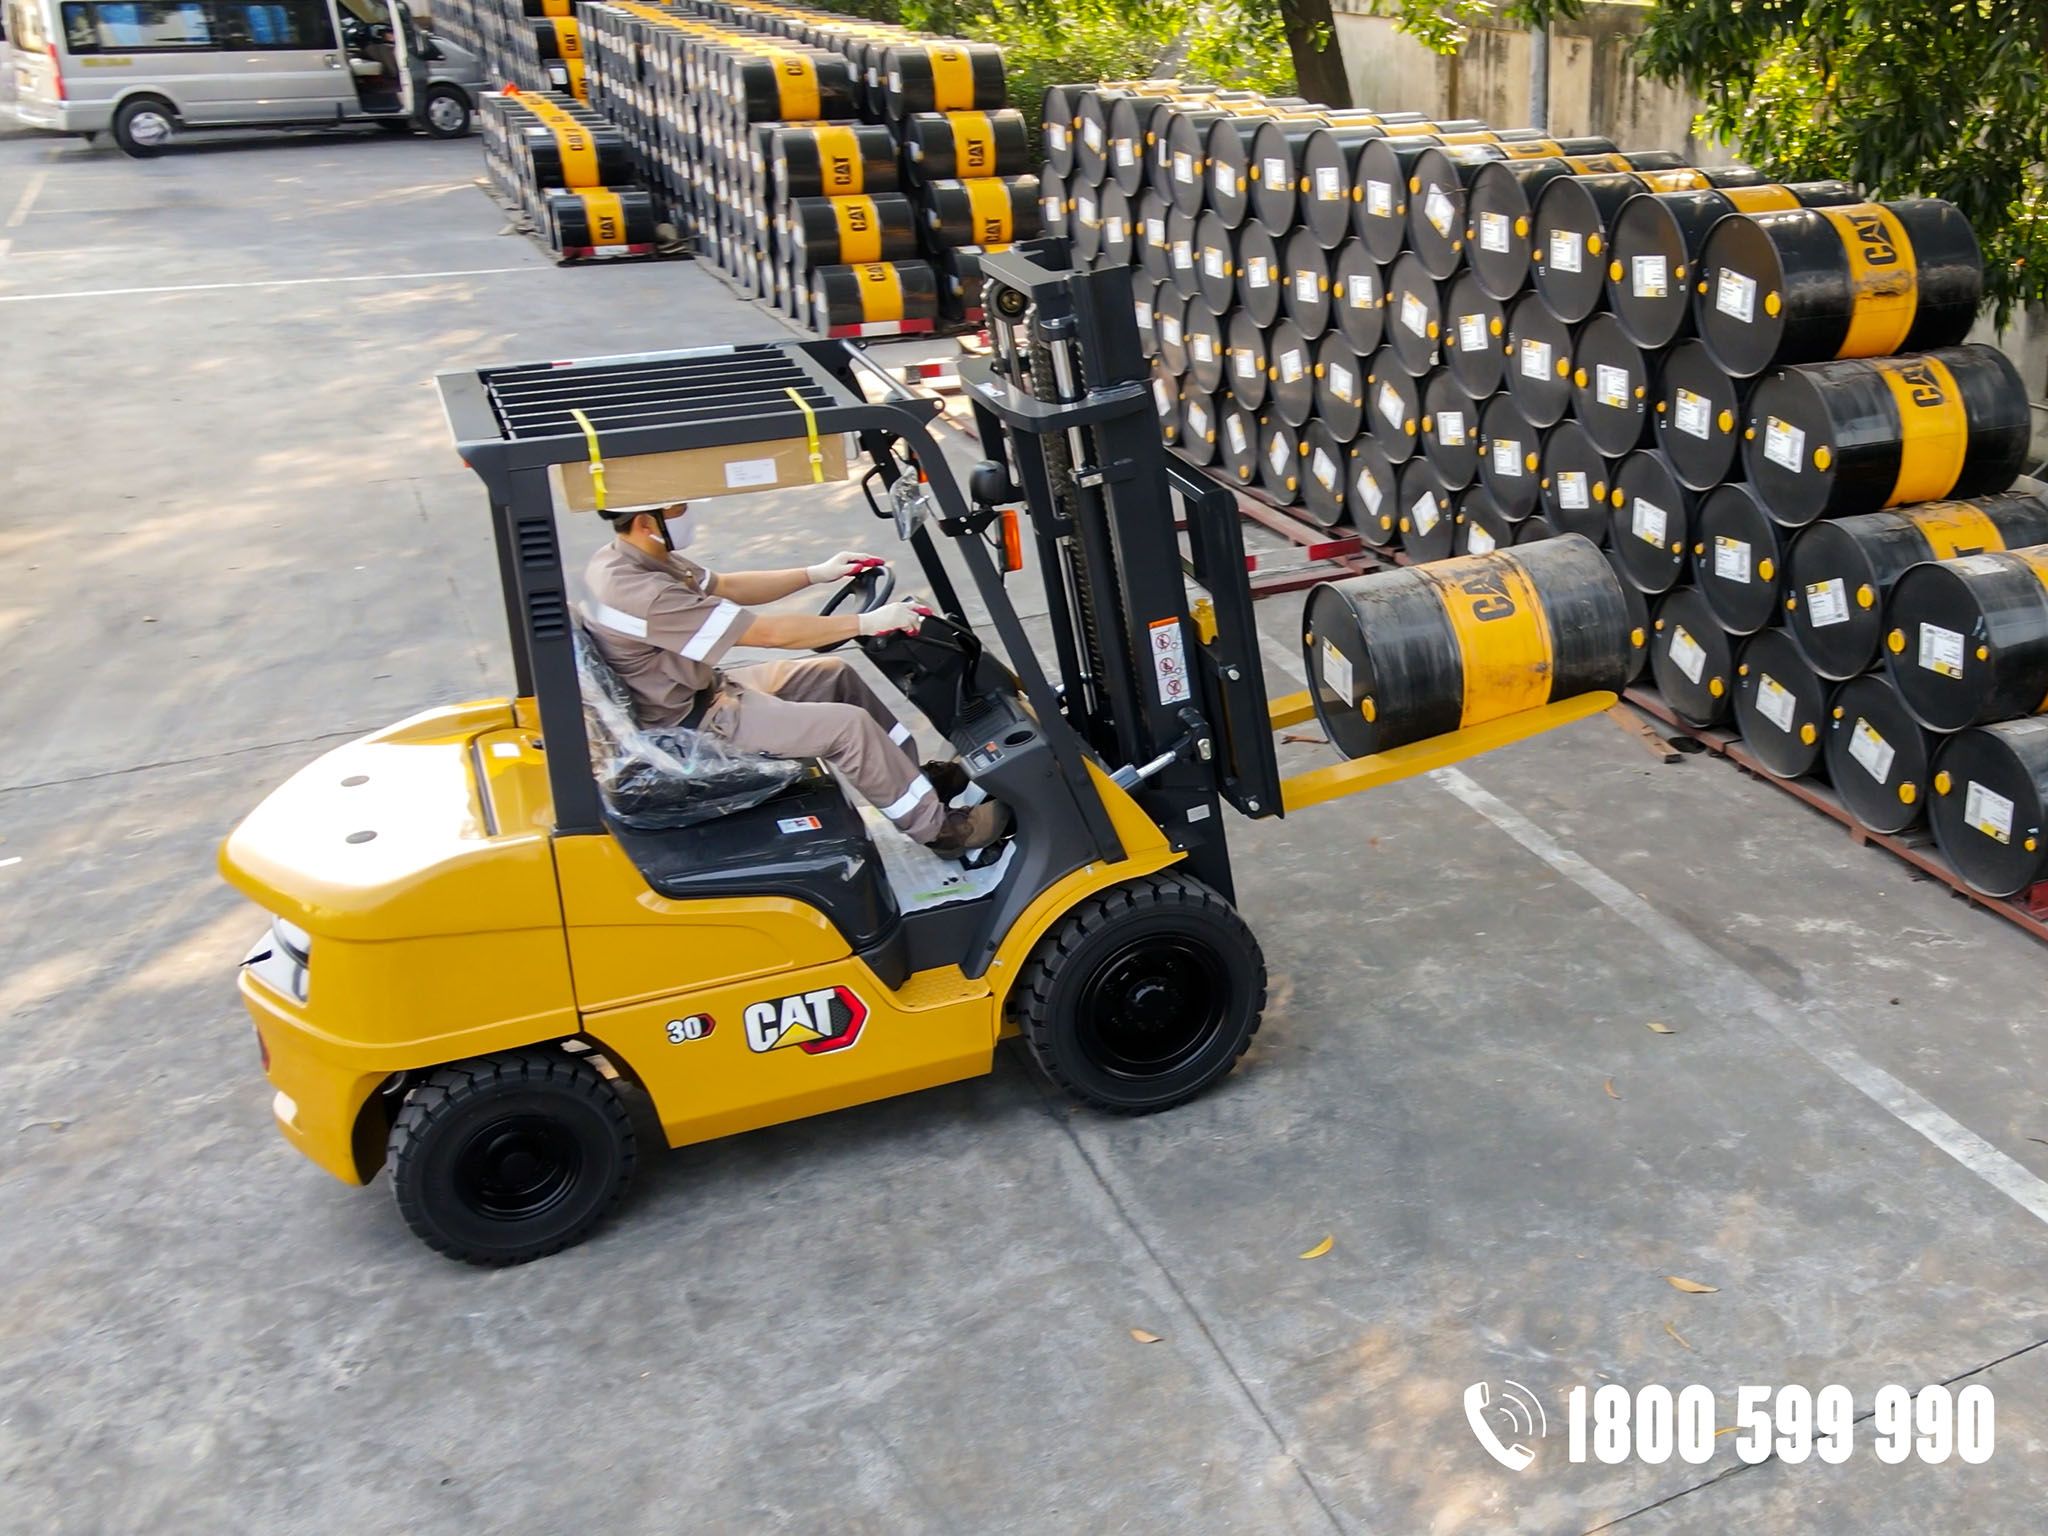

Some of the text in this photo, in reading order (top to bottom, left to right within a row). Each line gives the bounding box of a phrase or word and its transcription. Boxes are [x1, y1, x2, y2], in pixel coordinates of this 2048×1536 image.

[967, 138, 985, 167] CAT
[832, 155, 852, 185] CAT
[600, 216, 616, 240] CAT
[847, 205, 868, 232] CAT
[984, 218, 1001, 243] CAT
[1846, 214, 1897, 266] CAT
[1460, 567, 1516, 622] CA
[666, 1015, 702, 1044] 30
[743, 987, 836, 1053] CAT
